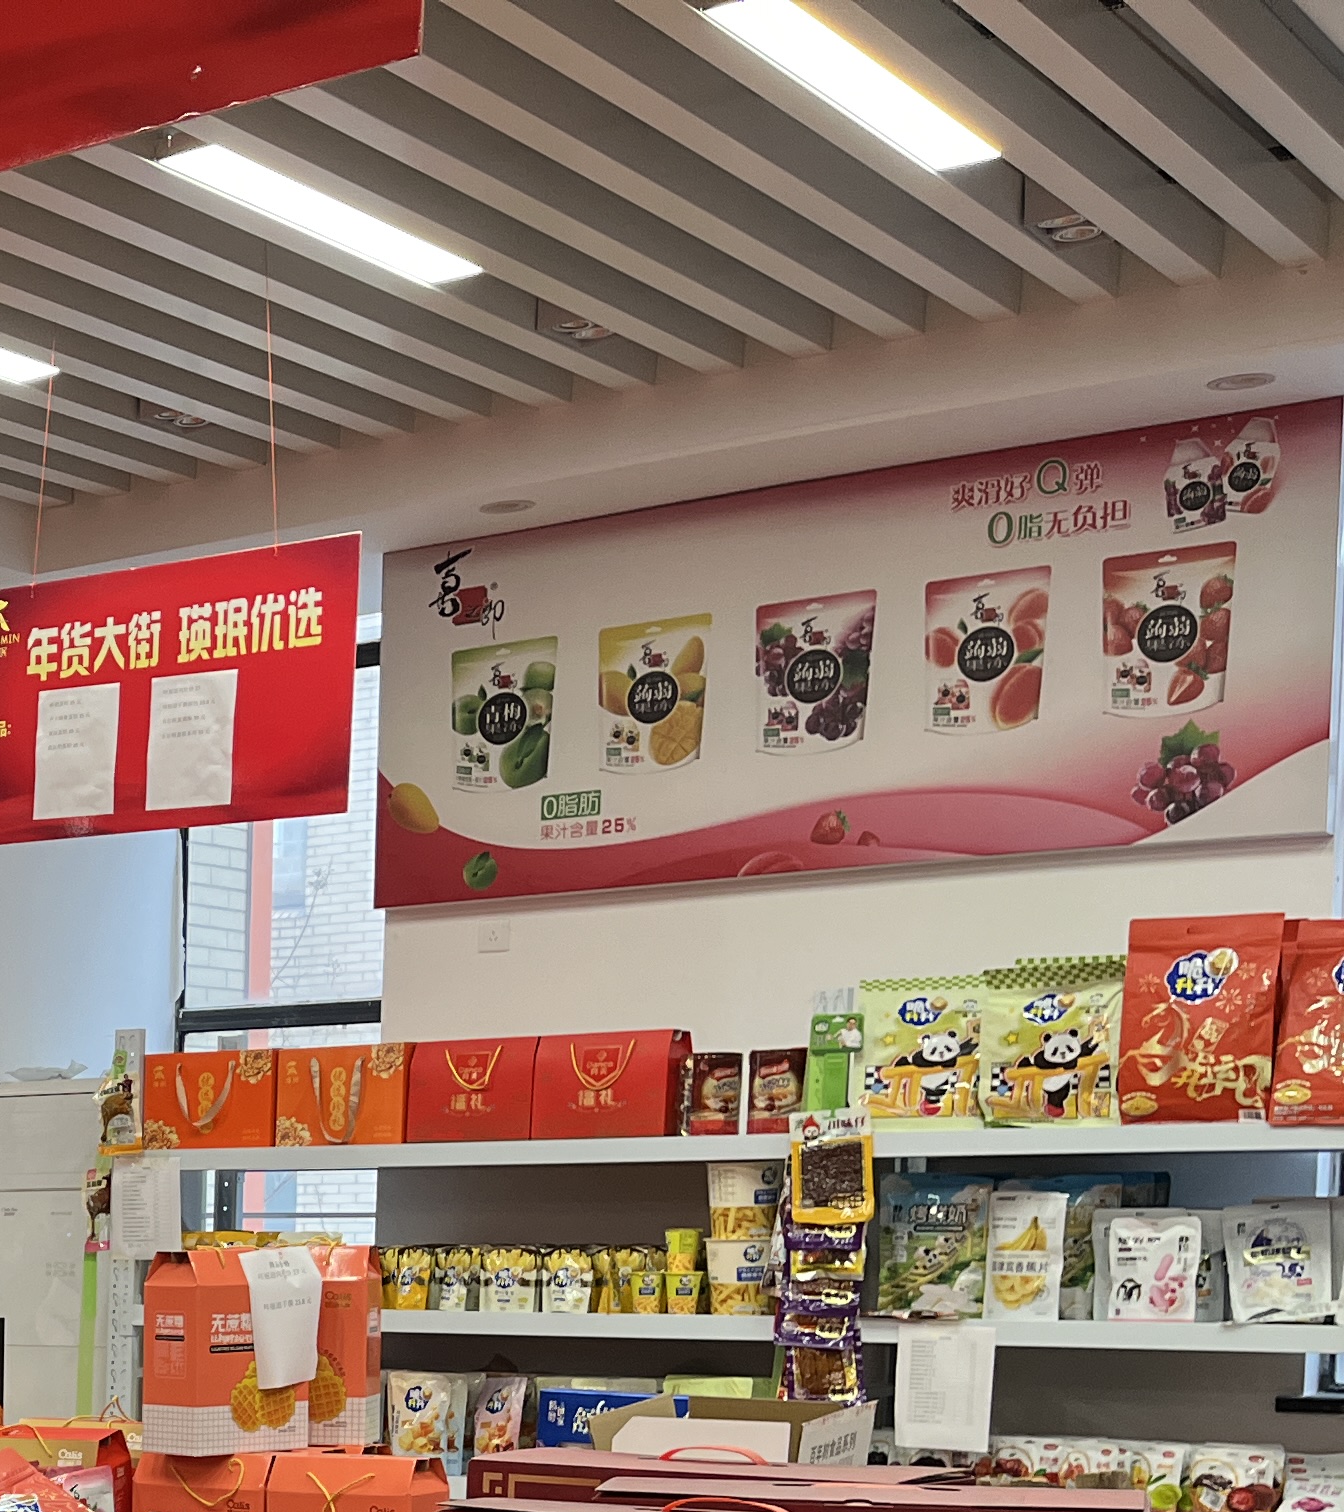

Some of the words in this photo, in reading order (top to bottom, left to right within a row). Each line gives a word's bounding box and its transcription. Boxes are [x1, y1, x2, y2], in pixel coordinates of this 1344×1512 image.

[950, 457, 1103, 512] 爽滑好Q弹
[26, 610, 161, 681] 年货大街
[177, 586, 323, 664] 瑛珉优选
[542, 790, 601, 819] 0脂肪
